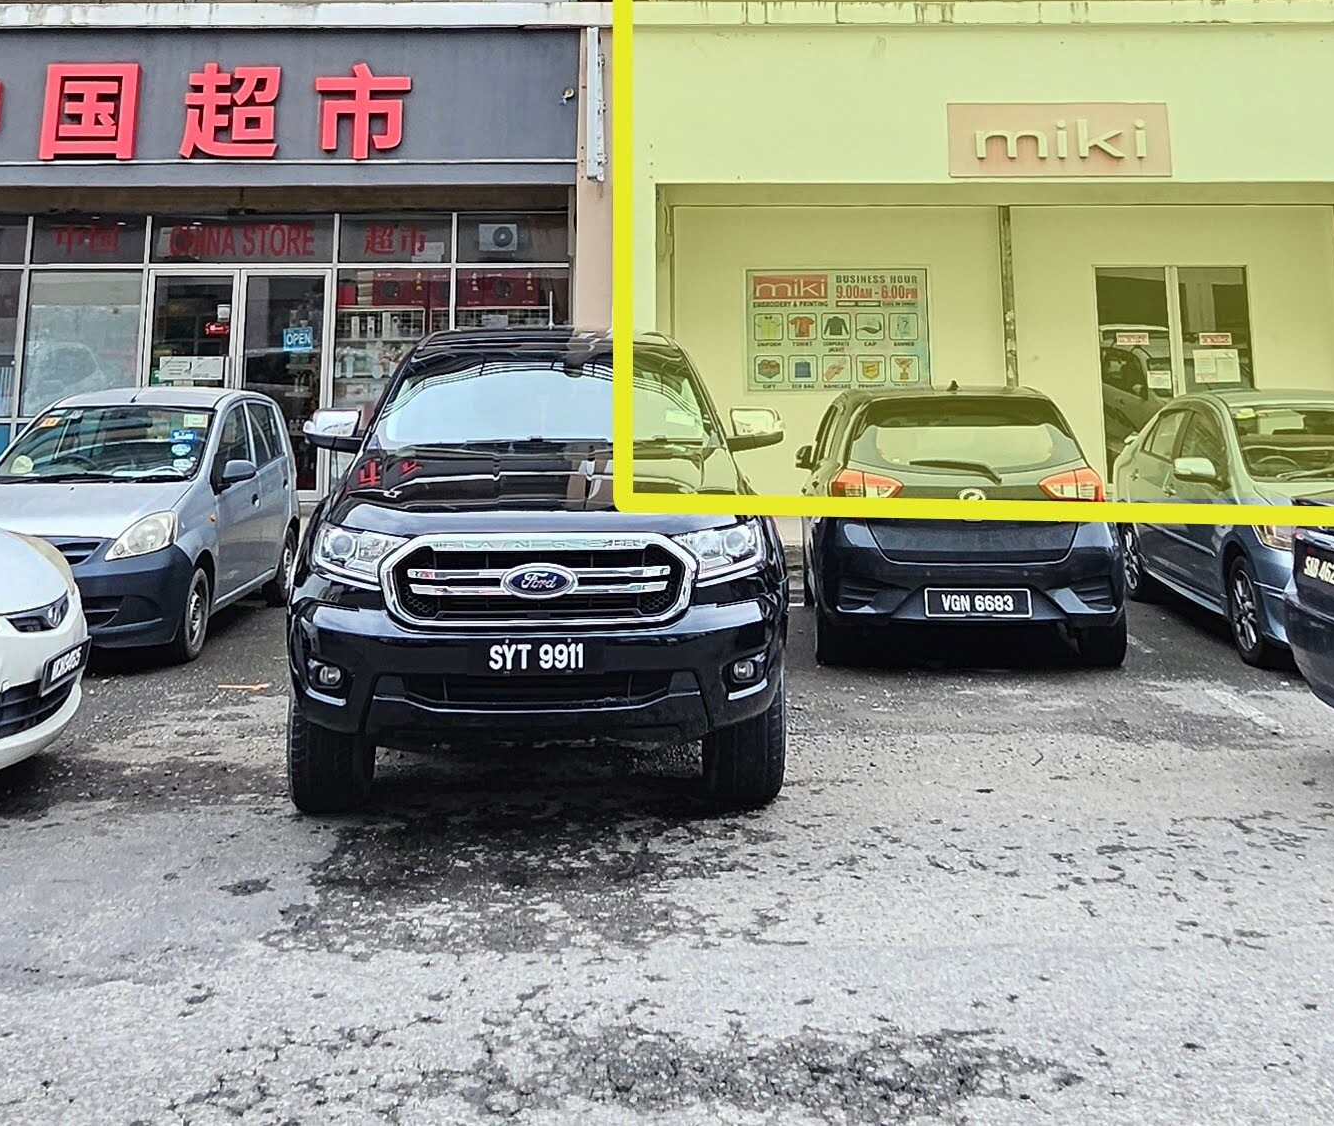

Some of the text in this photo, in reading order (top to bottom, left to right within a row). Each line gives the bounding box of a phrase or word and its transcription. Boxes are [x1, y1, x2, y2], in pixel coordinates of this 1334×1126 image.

[974, 118, 1148, 160] miki
[243, 223, 316, 257] STORE
[755, 278, 826, 297] miki
[835, 274, 918, 284] BUSINESS HOUR
[285, 333, 312, 345] OPEN
[520, 571, 557, 589] Ford
[941, 593, 971, 612] VGN
[489, 642, 585, 671] SYT 9911
